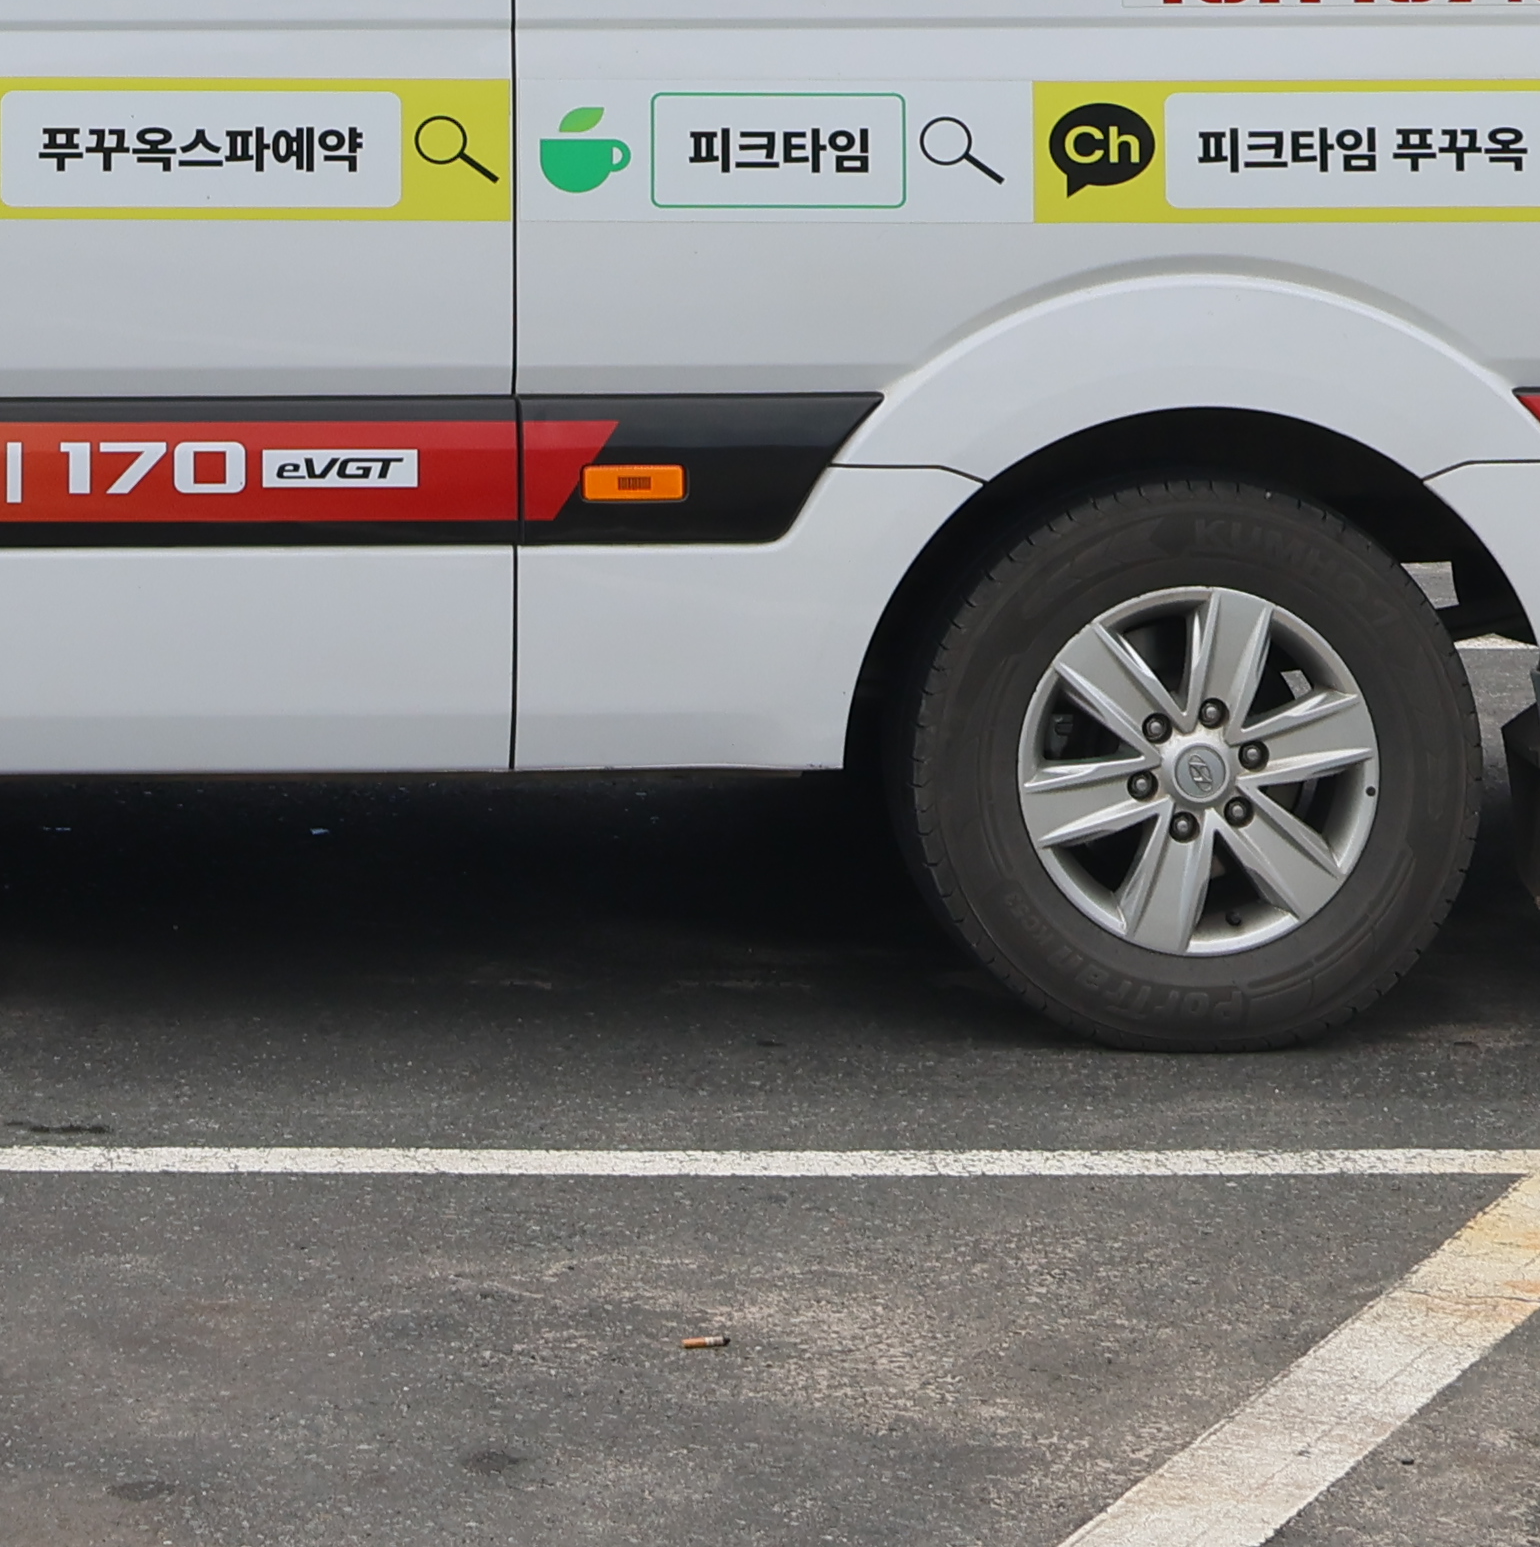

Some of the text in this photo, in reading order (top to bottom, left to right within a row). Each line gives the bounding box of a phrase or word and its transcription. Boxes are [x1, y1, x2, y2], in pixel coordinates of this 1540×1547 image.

[38, 125, 364, 173] 푸꾸옥스파예약
[688, 127, 870, 174] 피크타임
[1064, 125, 1140, 165] Ch
[1197, 126, 1528, 173] 피크타임 푸꾸옥
[60, 441, 247, 495] 170
[276, 457, 405, 480] eVGT
[1194, 518, 1372, 605] KUMHO
[1000, 888, 1056, 949] KC53
